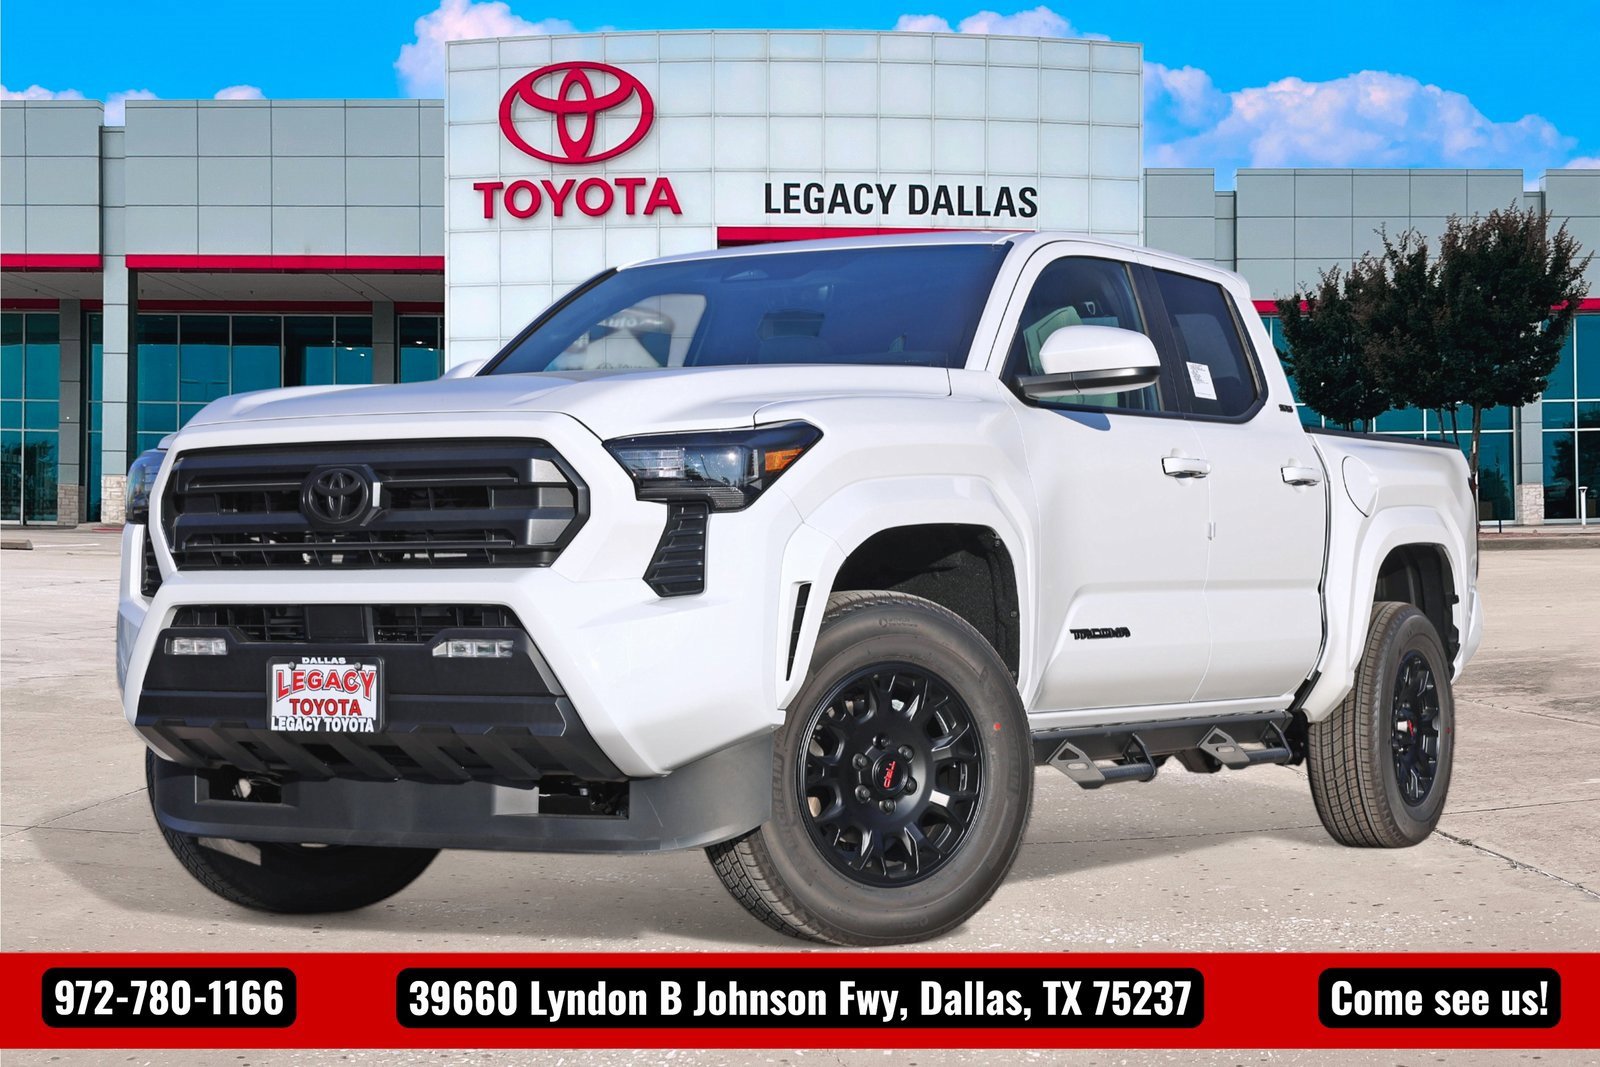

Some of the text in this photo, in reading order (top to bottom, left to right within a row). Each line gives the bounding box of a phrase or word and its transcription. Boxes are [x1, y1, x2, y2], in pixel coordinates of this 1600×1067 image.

[474, 177, 682, 219] TOYOTA
[765, 182, 1038, 218] LEGACY DALLAS
[276, 669, 376, 702] LEGACY
[289, 698, 362, 716] TOYOTA
[271, 716, 374, 733] LEGACY TOYOTA
